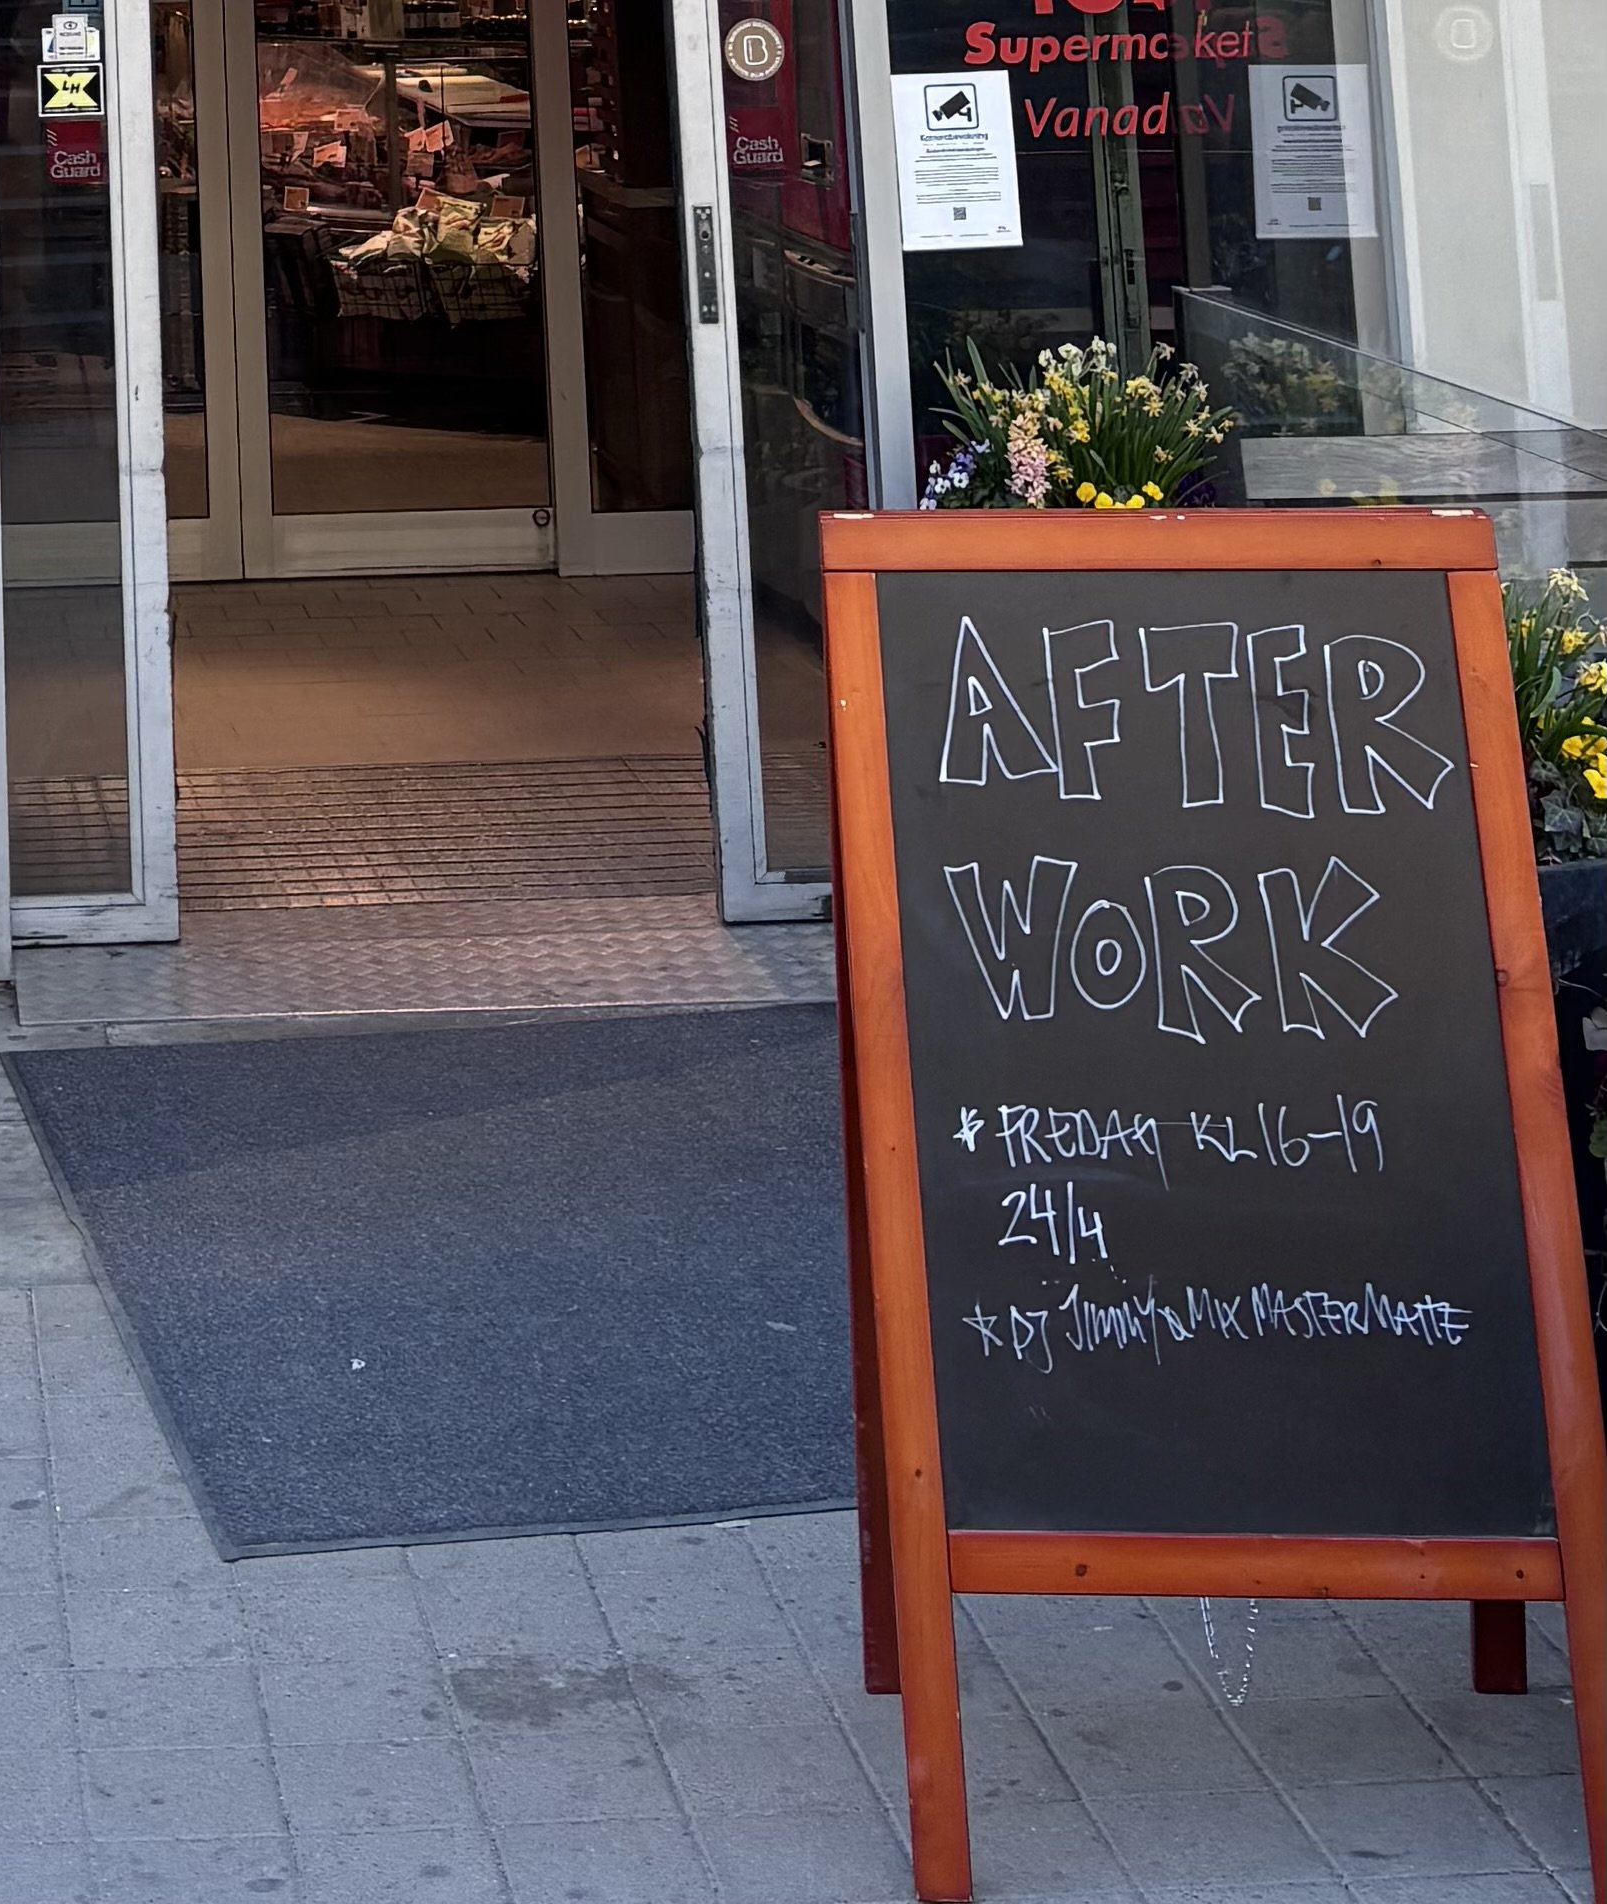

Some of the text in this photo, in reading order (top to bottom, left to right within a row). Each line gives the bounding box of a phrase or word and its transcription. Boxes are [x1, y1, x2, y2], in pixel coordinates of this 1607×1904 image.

[62, 80, 81, 95] LH
[53, 149, 98, 166] Cash
[732, 148, 784, 165] Guard
[735, 136, 779, 152] Cash
[50, 162, 101, 179] Guard
[938, 615, 1455, 819] AFTER
[942, 855, 1399, 1045] WORK
[1190, 1111, 1258, 1163] KL
[997, 1181, 1109, 1265] 24/4
[1010, 1305, 1054, 1374] DJ
